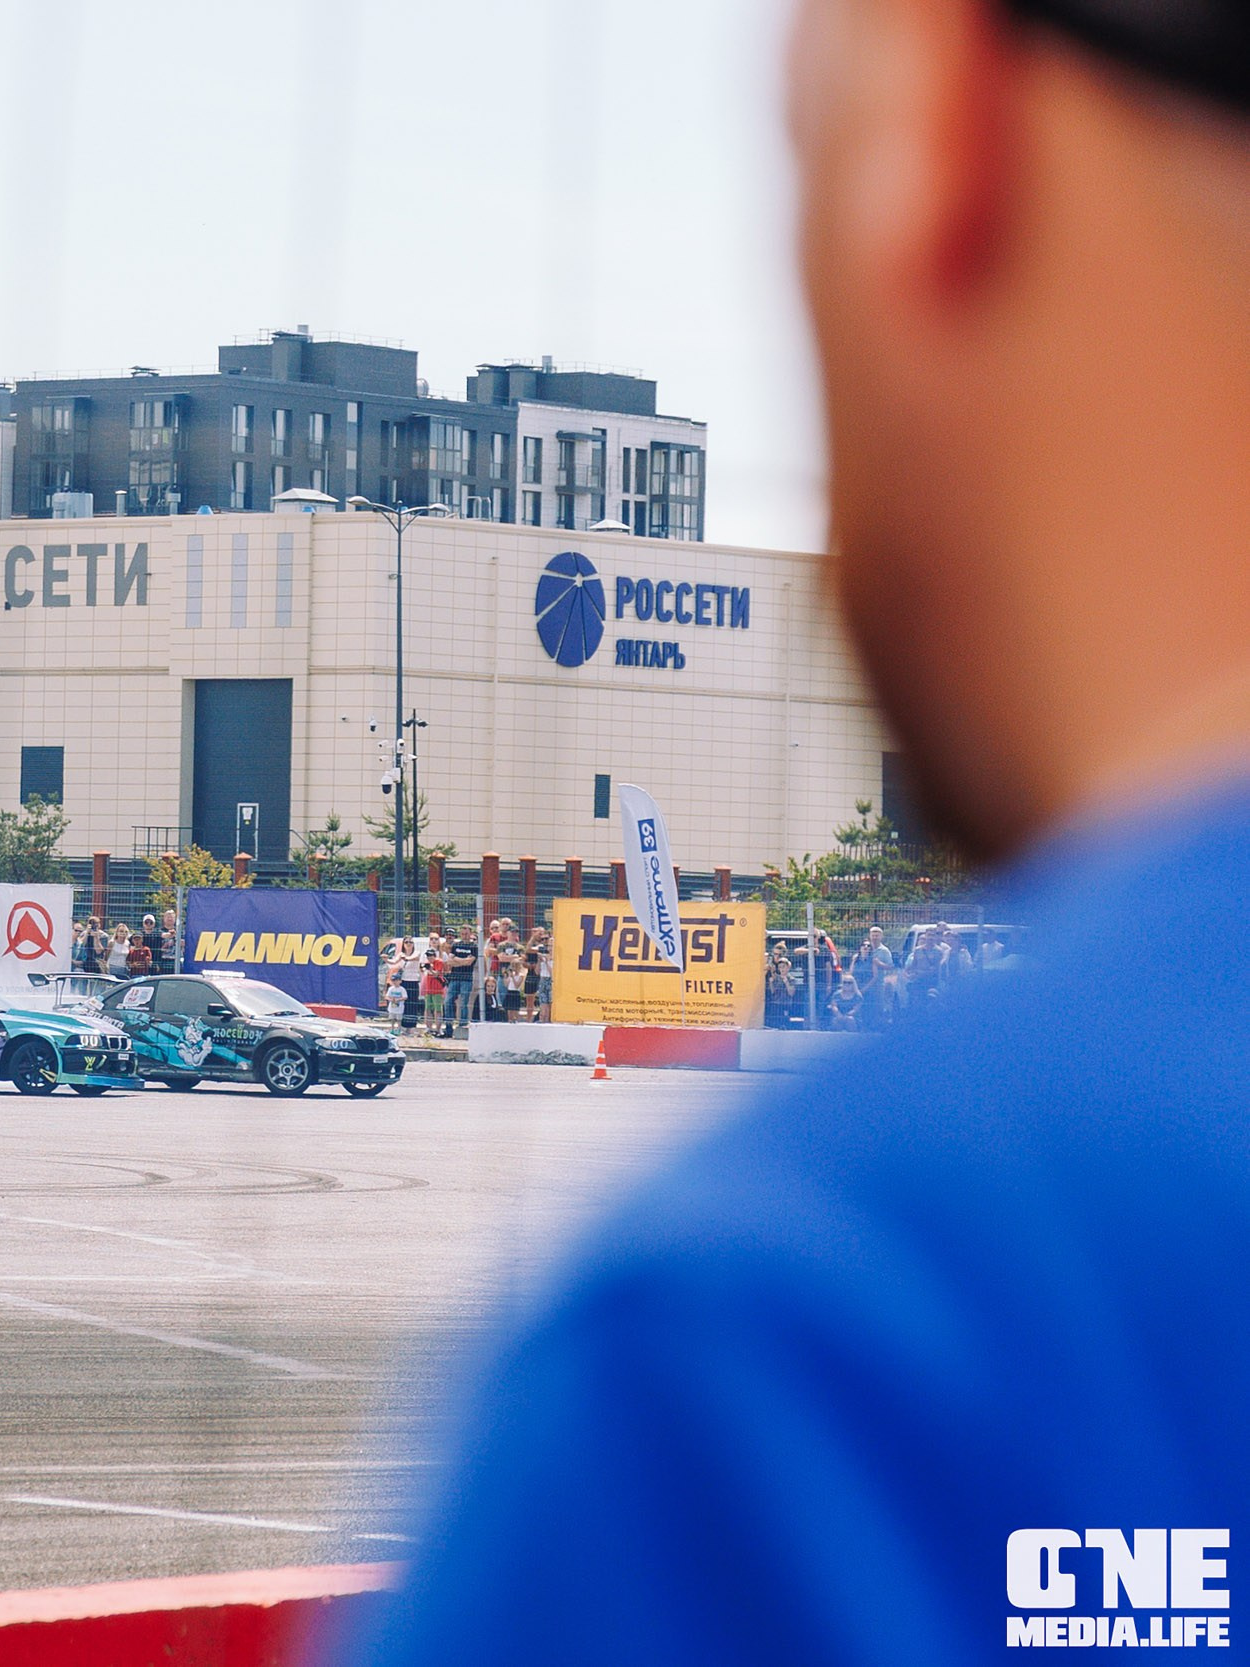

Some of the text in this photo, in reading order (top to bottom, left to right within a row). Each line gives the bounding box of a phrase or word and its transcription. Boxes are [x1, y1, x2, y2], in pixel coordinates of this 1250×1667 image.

[615, 575, 750, 629] РОССЕТИ
[615, 638, 686, 670] ЯНТАРЬ
[194, 931, 368, 967] MANNOL
[685, 980, 734, 994] FILTER
